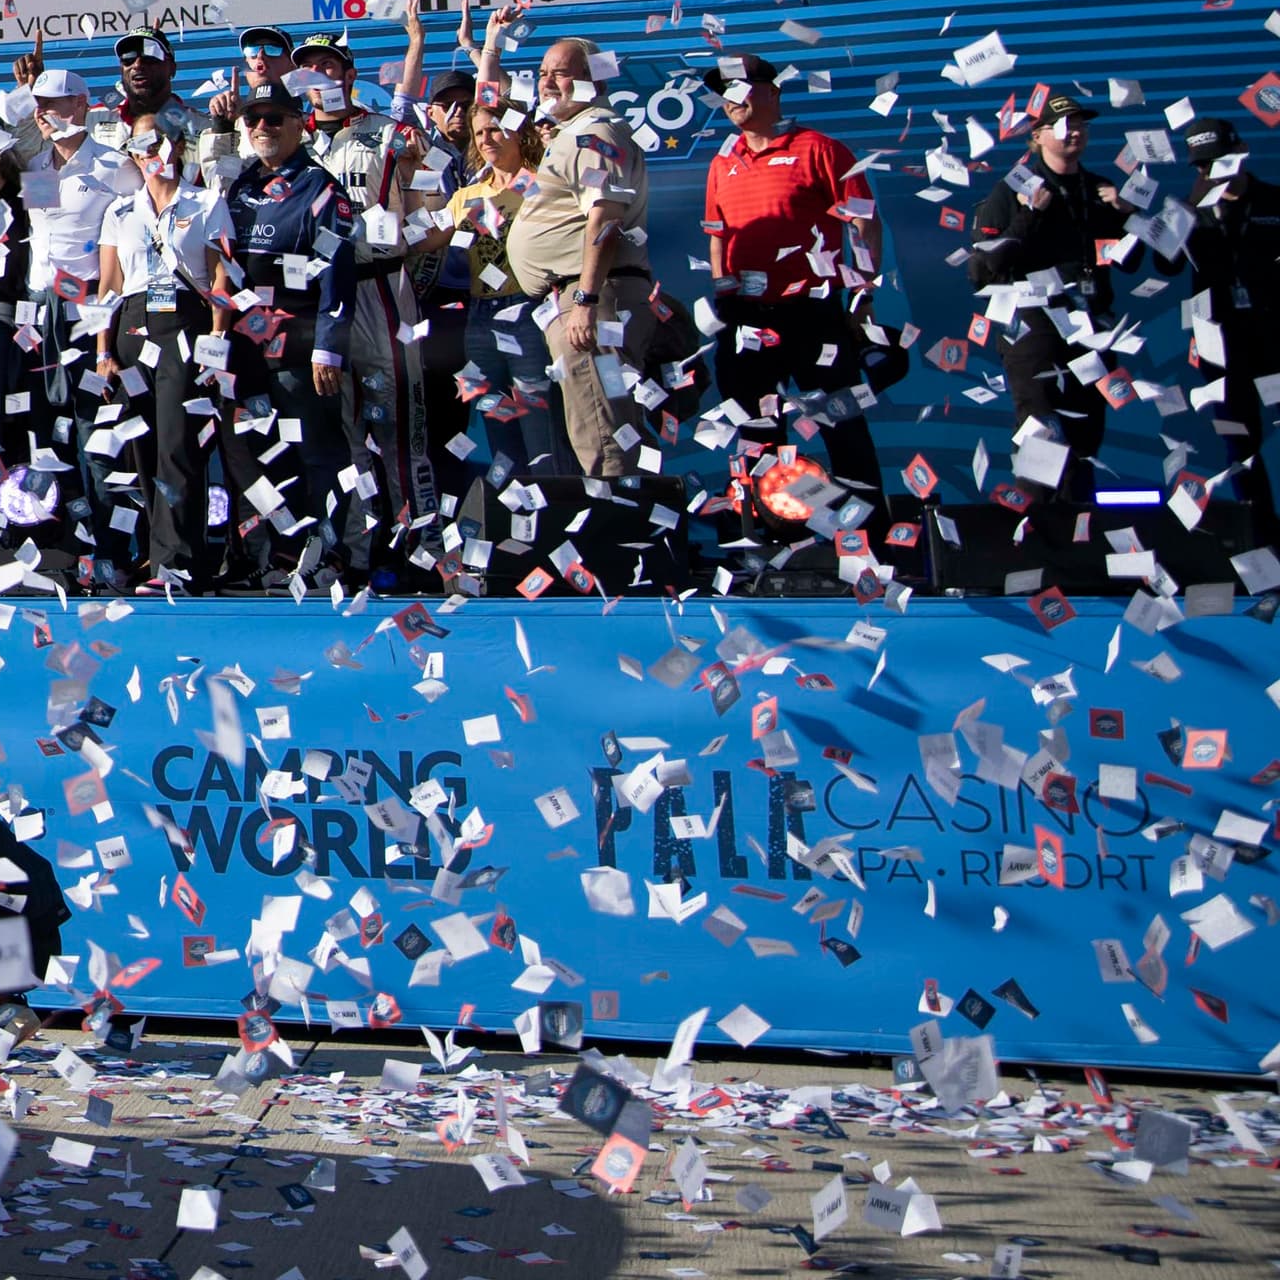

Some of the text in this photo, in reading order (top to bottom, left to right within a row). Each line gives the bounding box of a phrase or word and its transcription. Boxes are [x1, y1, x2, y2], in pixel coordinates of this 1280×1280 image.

[823, 772, 1151, 837] CASINO
[156, 804, 474, 881] WORLD
[832, 847, 1155, 892] PA RORT
